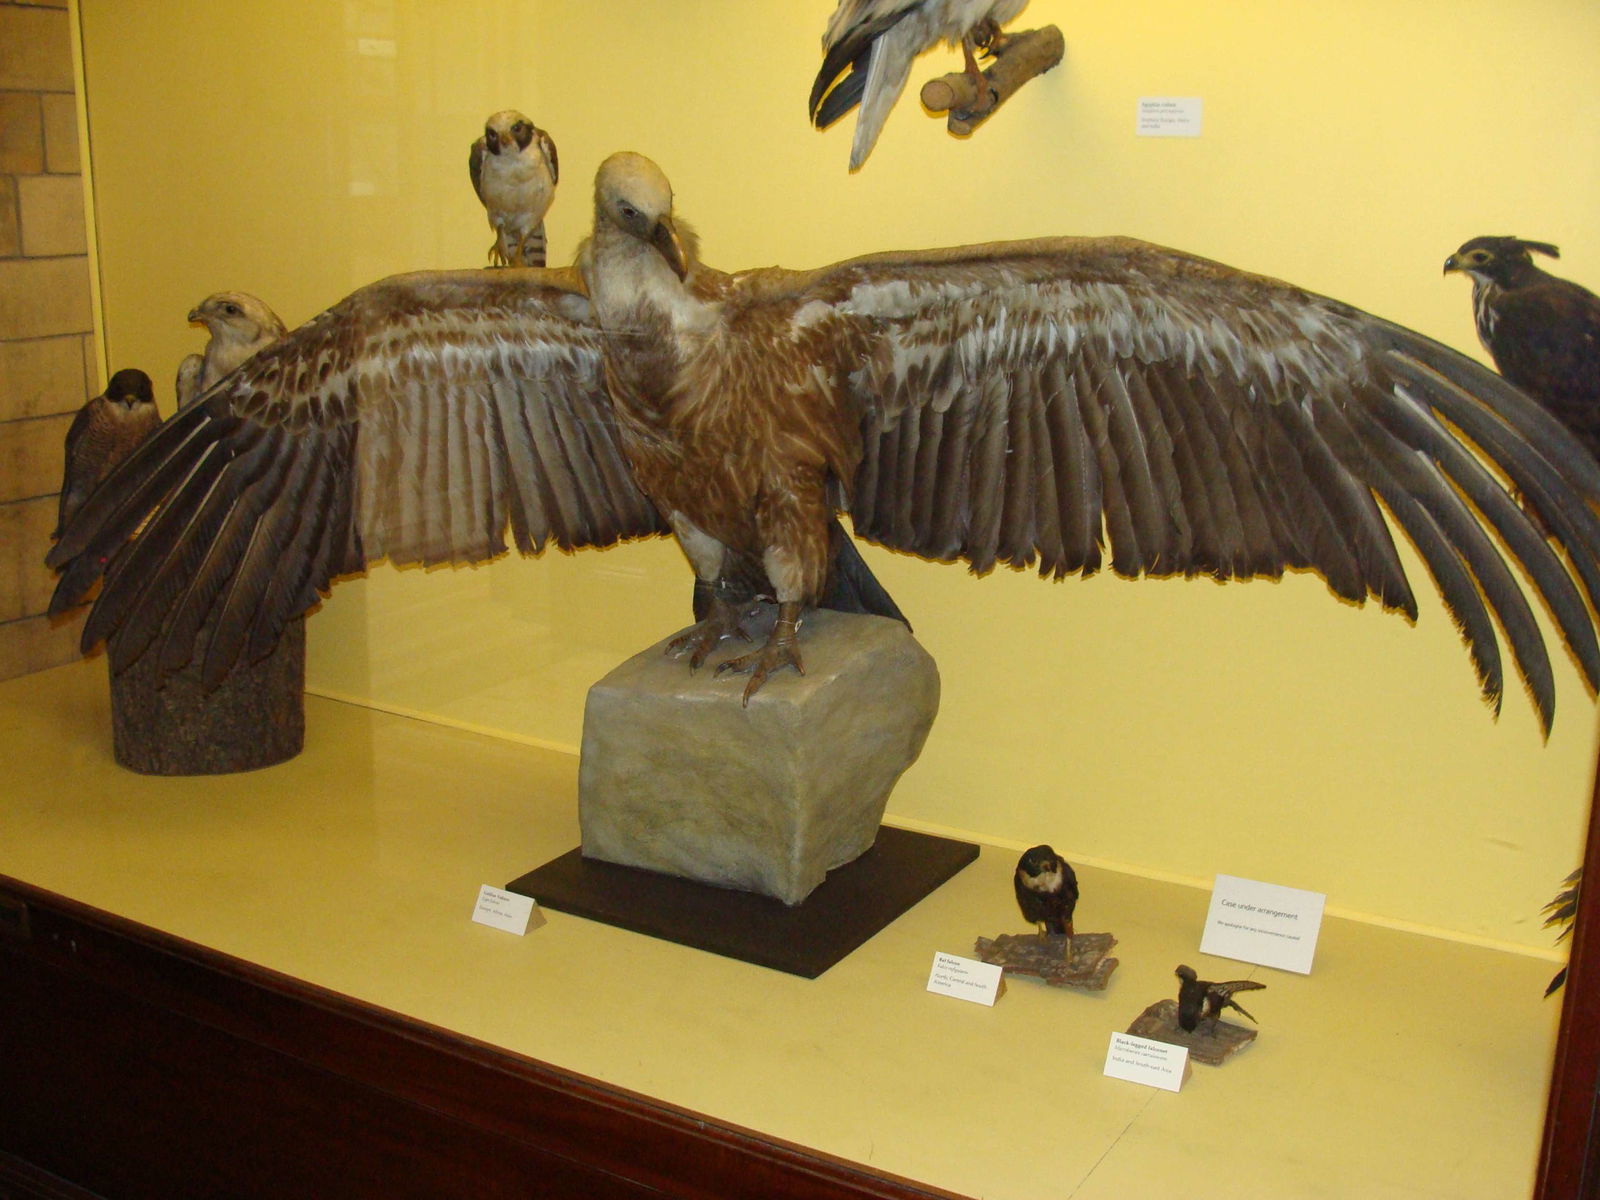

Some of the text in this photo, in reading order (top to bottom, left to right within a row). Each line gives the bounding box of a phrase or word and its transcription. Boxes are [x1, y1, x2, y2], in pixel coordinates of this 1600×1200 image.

[1221, 899, 1298, 920] Case under arrangement
